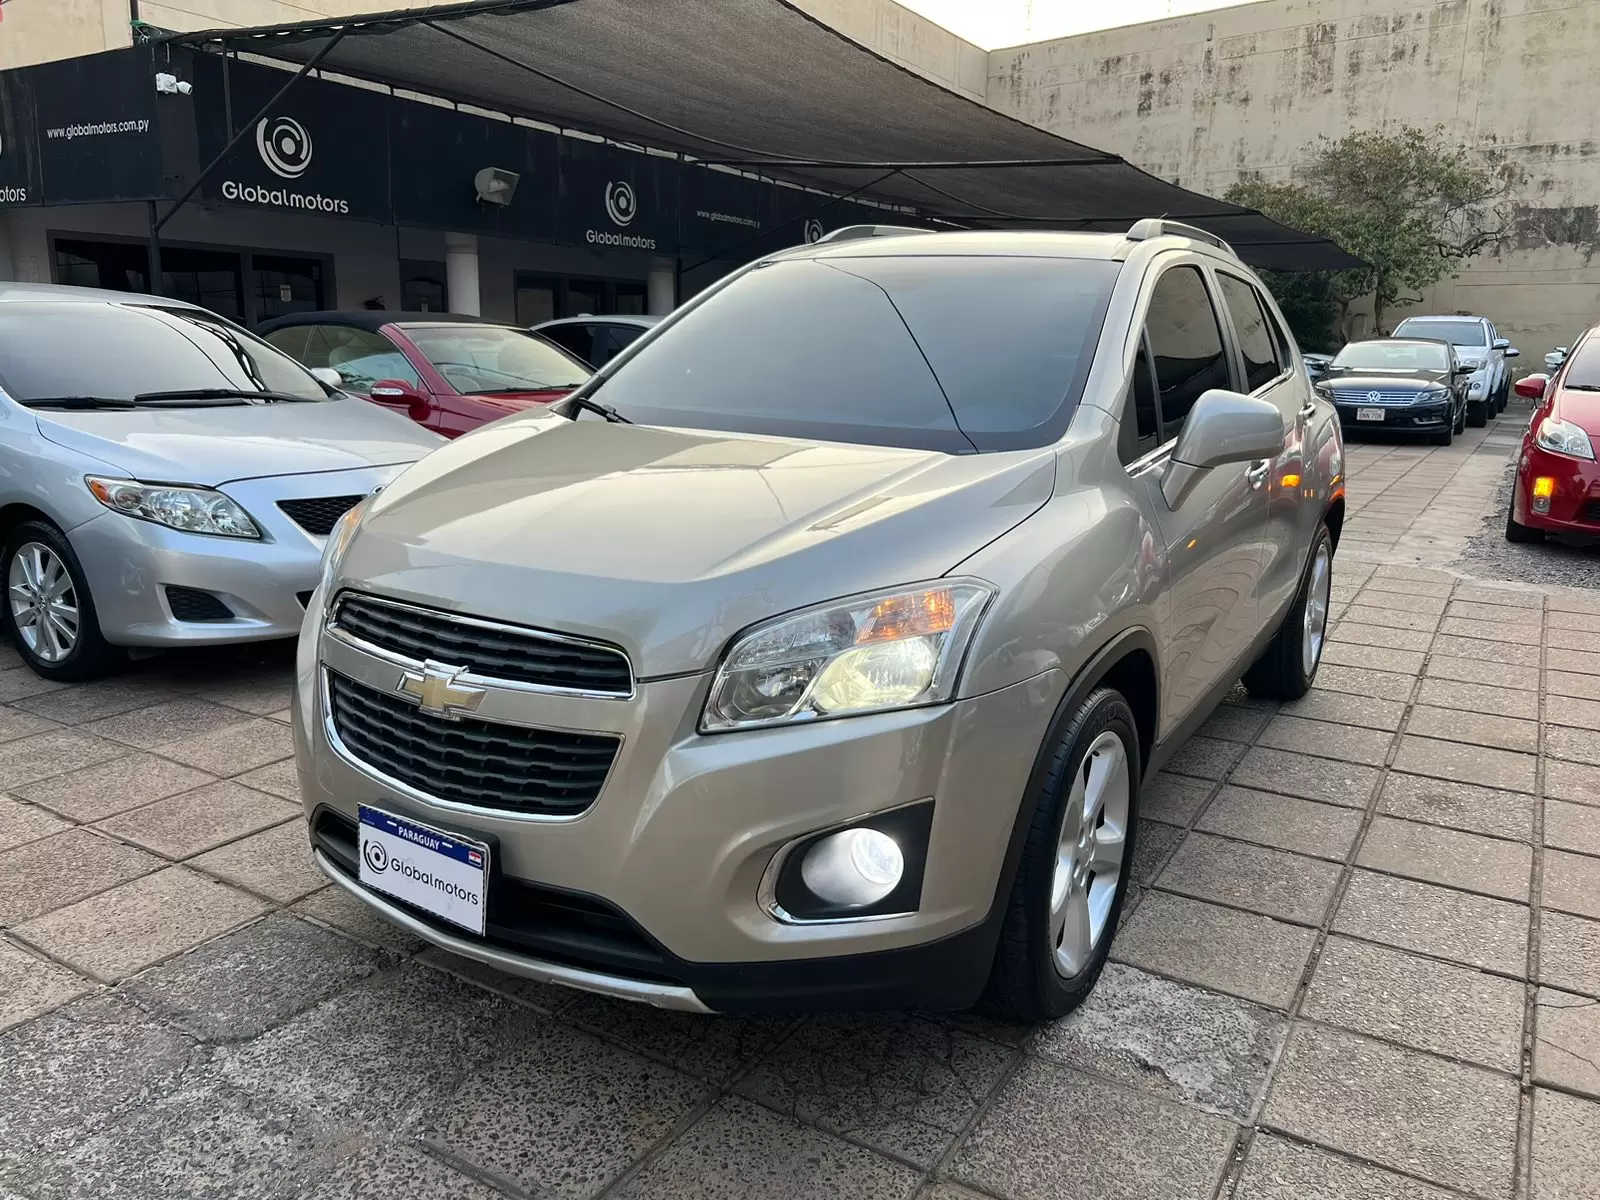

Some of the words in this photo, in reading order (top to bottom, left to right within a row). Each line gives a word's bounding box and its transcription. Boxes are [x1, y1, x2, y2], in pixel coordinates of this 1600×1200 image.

[46, 119, 150, 140] www.globalmotors.com.py
[221, 180, 349, 214] Globalmotors
[585, 229, 657, 250] Globalmotors
[398, 826, 440, 850] PARAGUAY
[390, 857, 479, 905] Globalmotors
